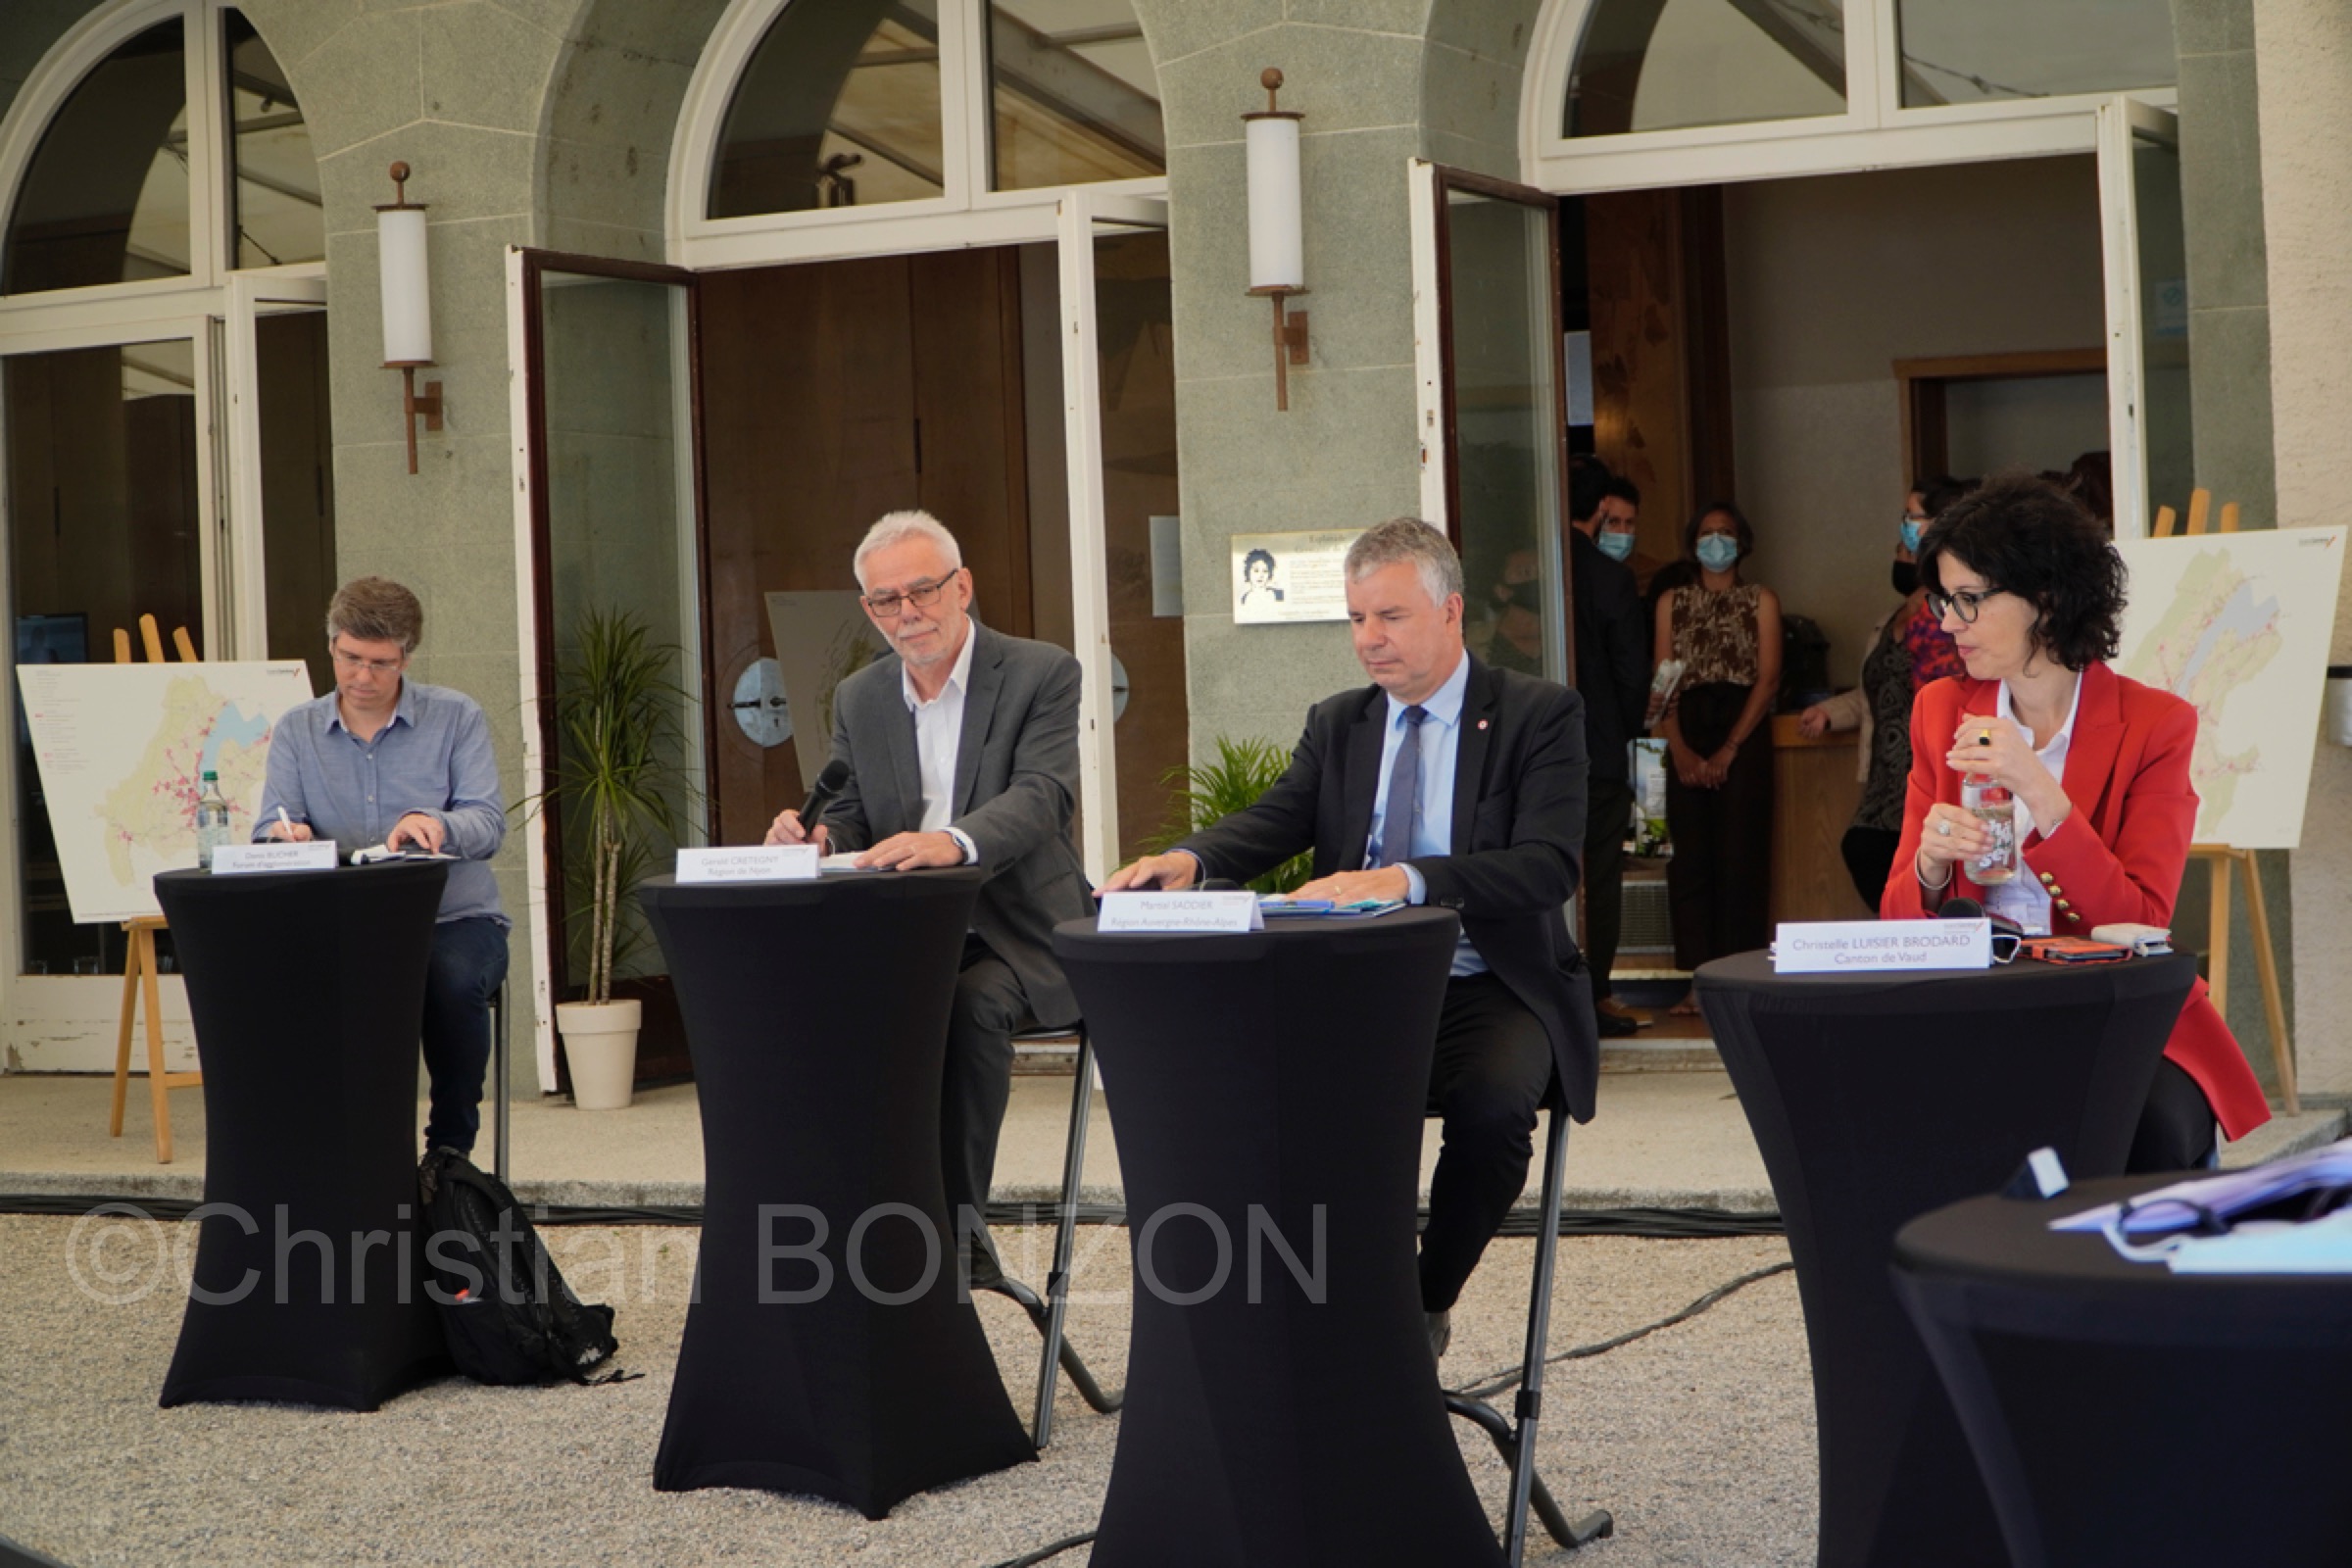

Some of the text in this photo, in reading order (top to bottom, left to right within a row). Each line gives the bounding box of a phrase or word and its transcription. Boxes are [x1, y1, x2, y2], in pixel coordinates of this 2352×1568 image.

[267, 850, 298, 859] BUCHER
[1172, 901, 1213, 909] SADDIER
[1111, 918, 1139, 928] Région
[1792, 934, 1971, 951] Christelle LUISIER BRODARD
[1834, 951, 1928, 965] Canton de Vaud
